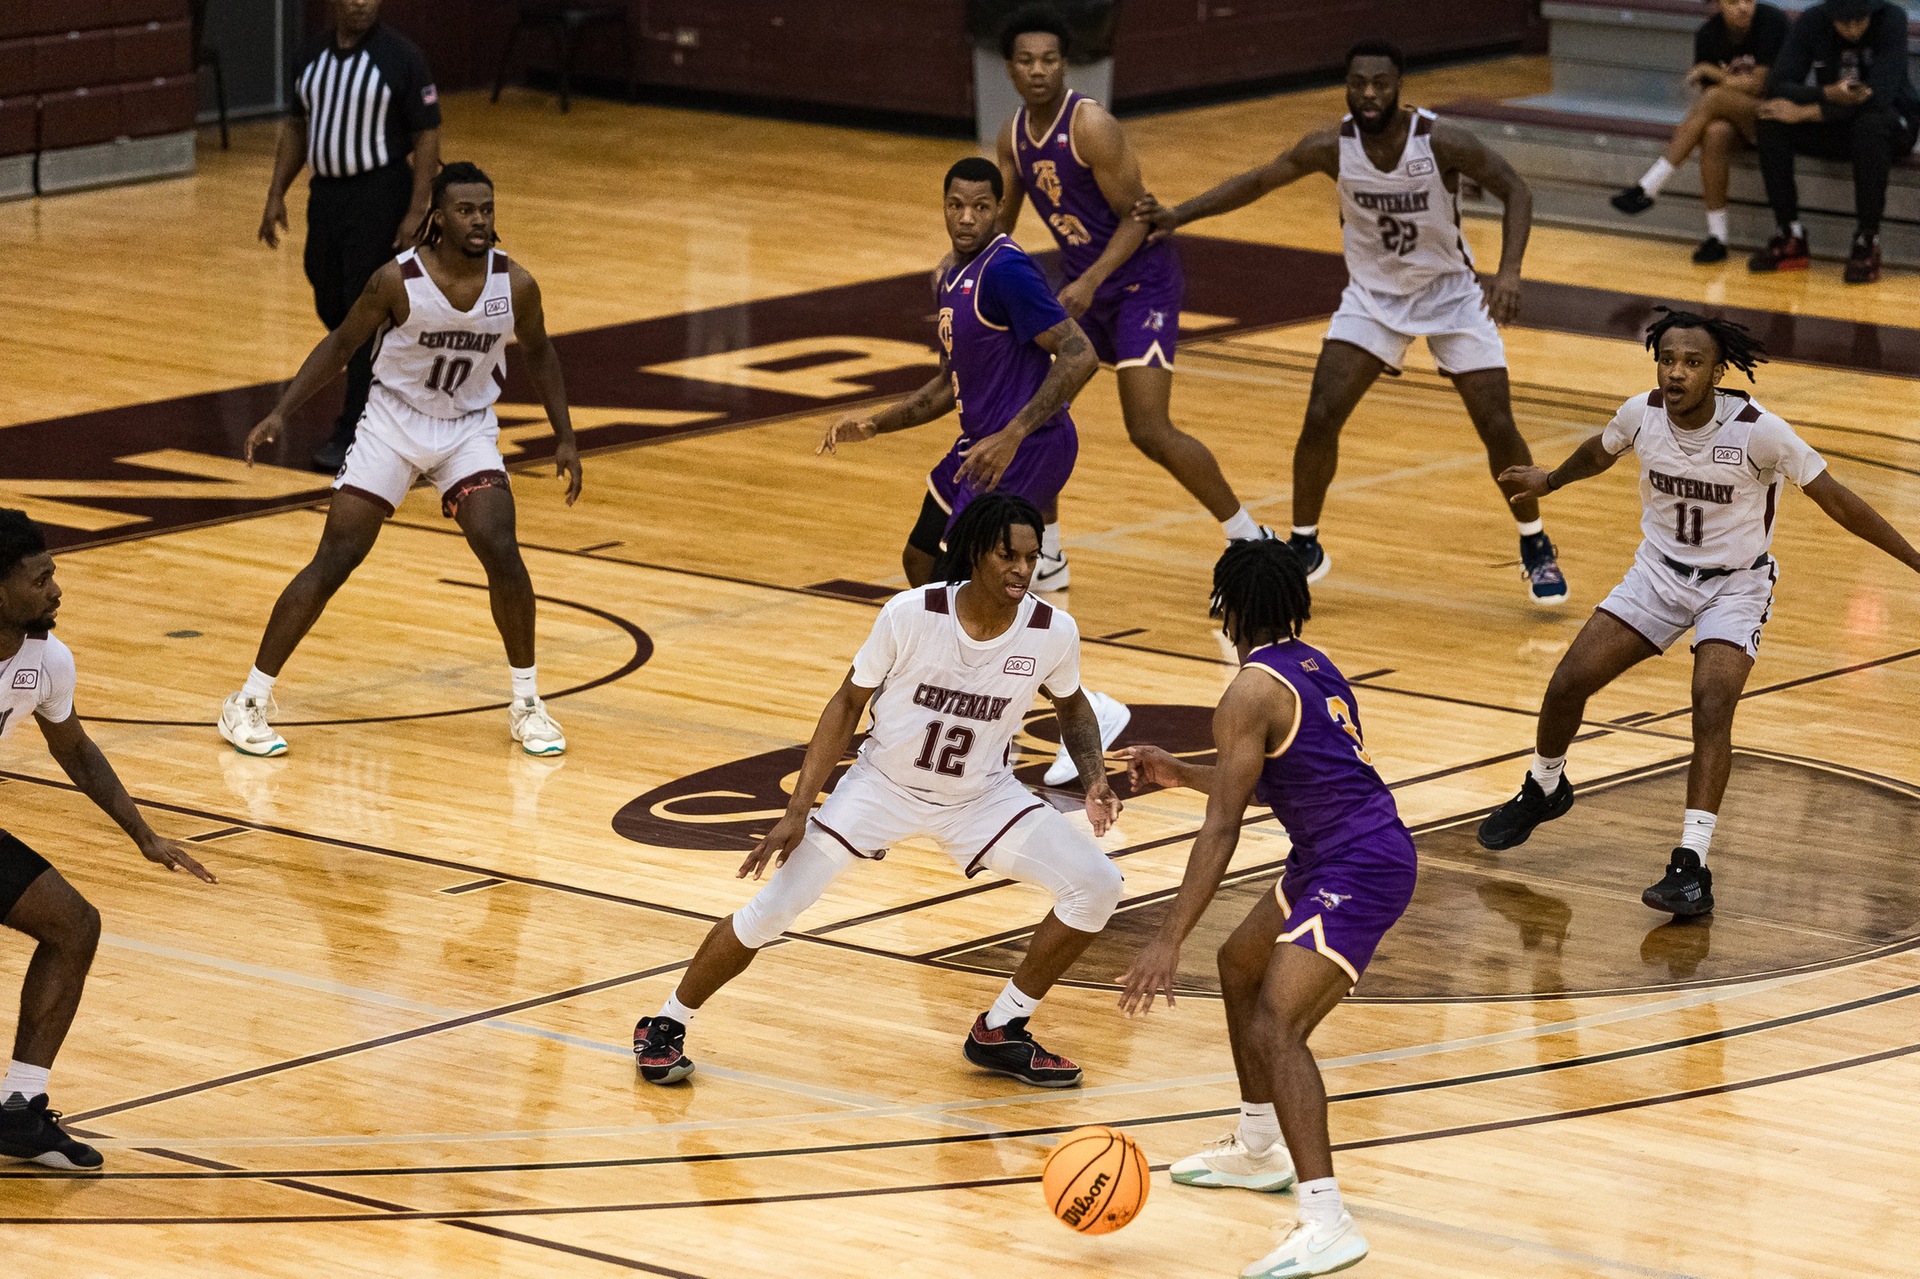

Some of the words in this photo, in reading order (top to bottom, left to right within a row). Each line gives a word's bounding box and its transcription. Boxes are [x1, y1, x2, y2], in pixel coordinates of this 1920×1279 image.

[1378, 215, 1418, 257] 22
[418, 330, 501, 353] CENTENARY
[424, 354, 473, 398] 10
[1716, 450, 1740, 461] 200
[1648, 469, 1735, 504] CENTENARY
[1674, 502, 1703, 547] 11
[1007, 660, 1031, 672] 200
[912, 683, 1012, 722] CENTENARY
[914, 720, 976, 778] 12
[1326, 695, 1374, 766] 3
[1061, 1172, 1111, 1227] Wilson
